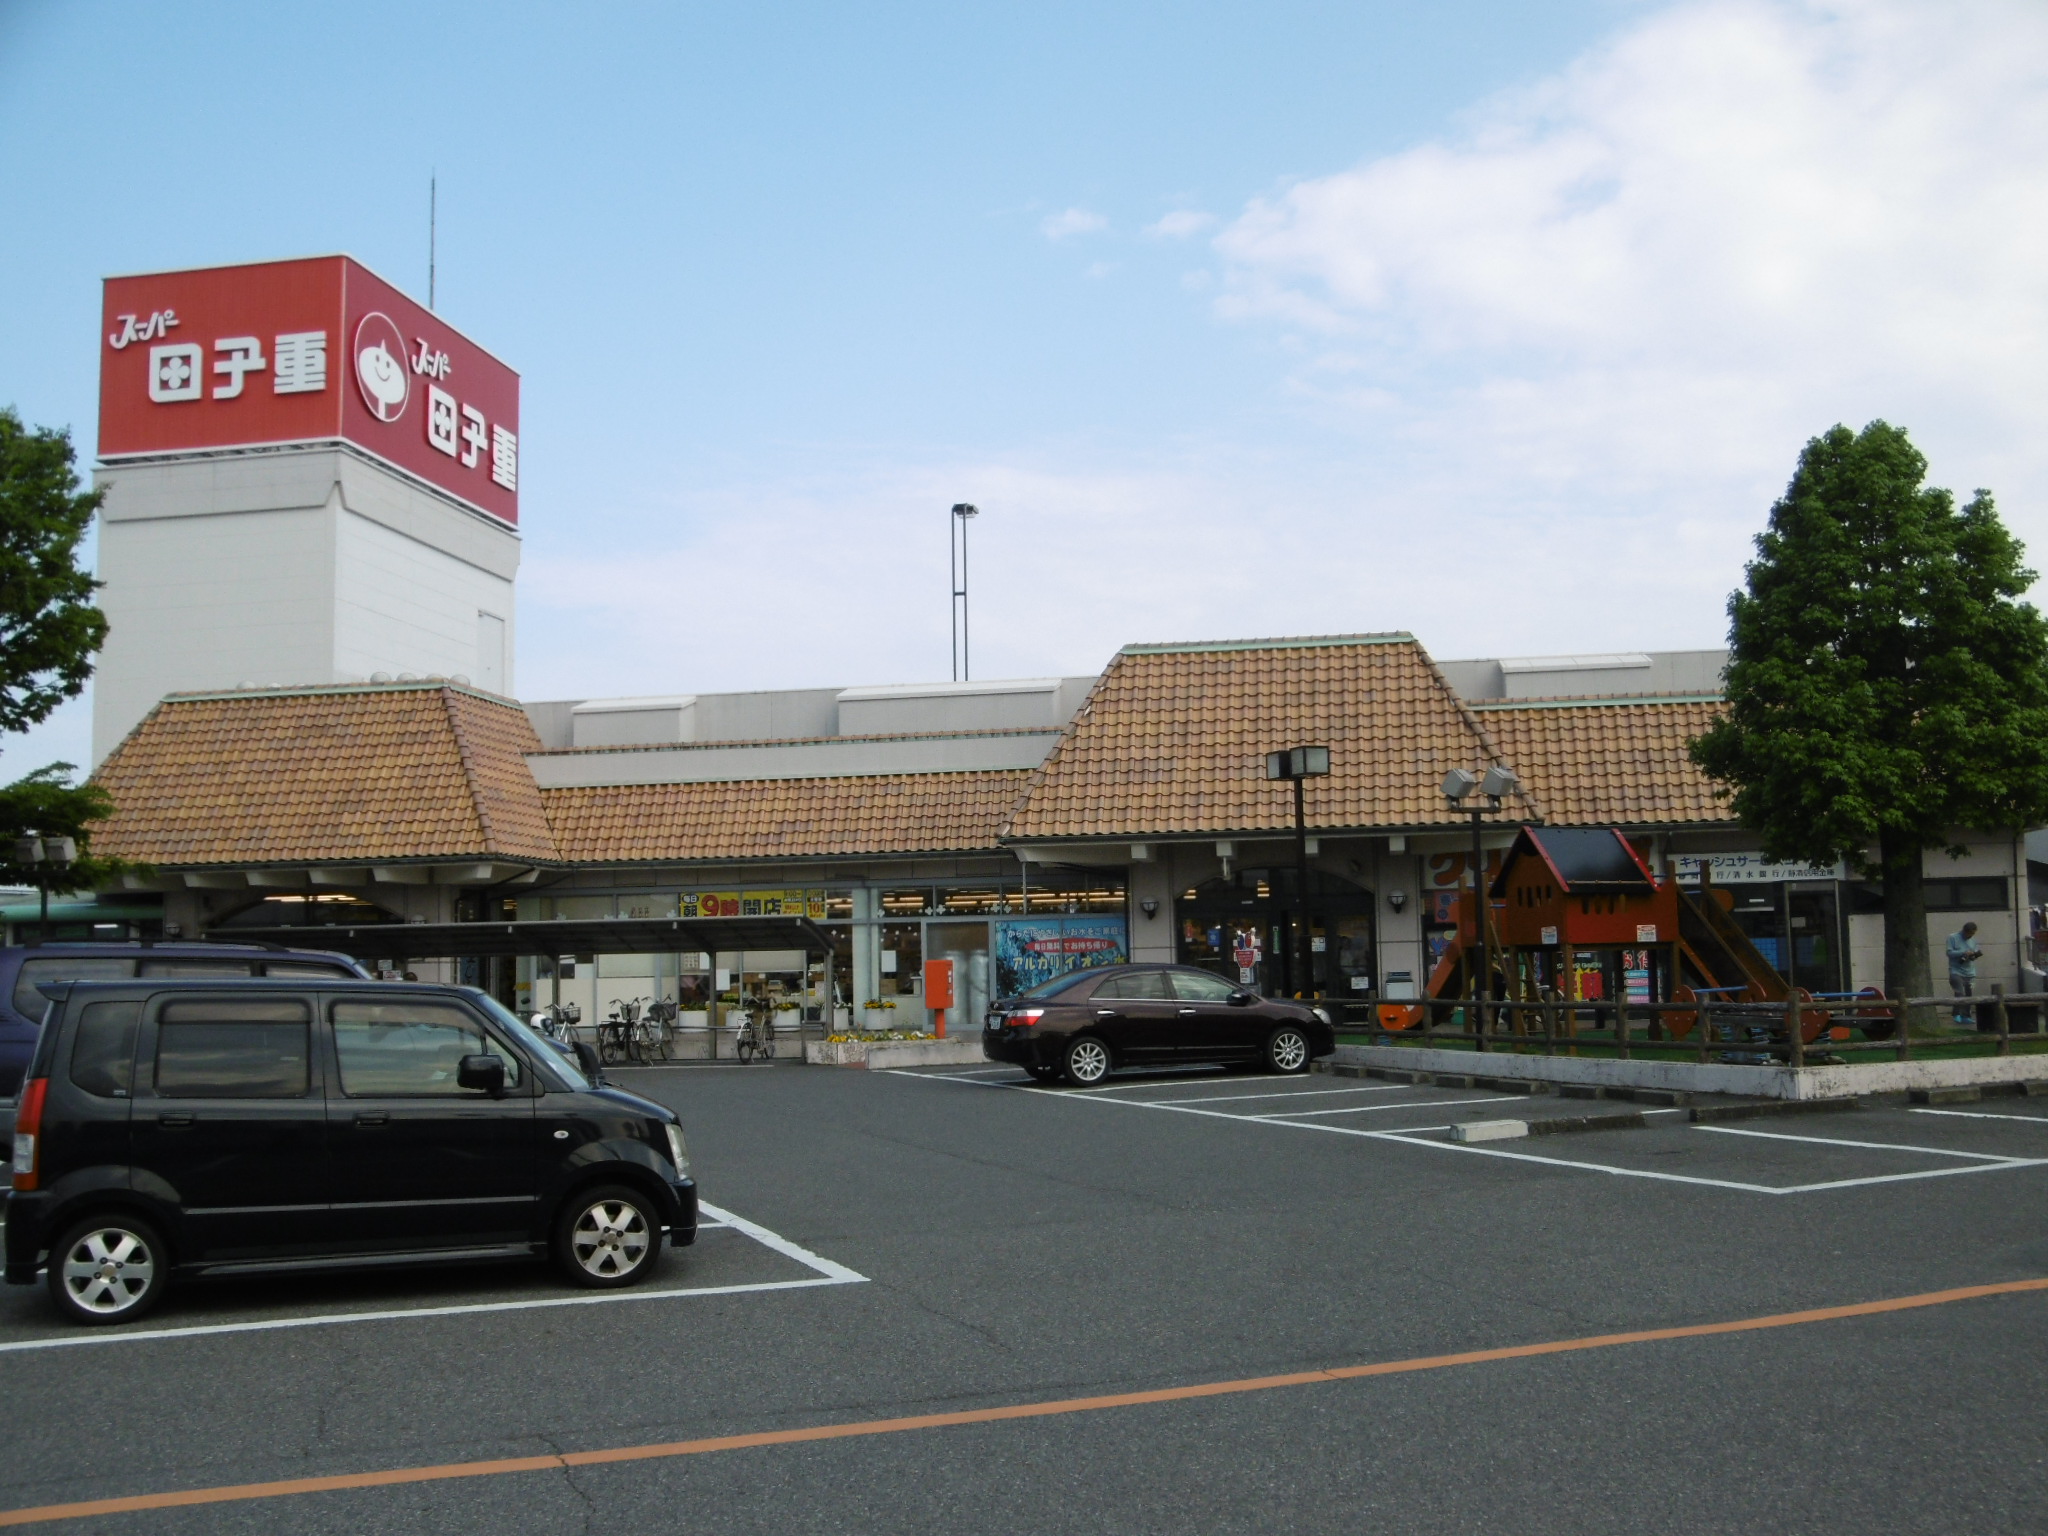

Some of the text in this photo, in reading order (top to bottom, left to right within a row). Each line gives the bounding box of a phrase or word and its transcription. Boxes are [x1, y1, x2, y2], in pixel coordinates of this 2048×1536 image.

[109, 309, 180, 350] スーパー
[148, 330, 327, 403] 田子重
[411, 336, 452, 381] スーパー
[427, 383, 518, 492] 田子重
[1013, 955, 1126, 970] アルカリイオン水
